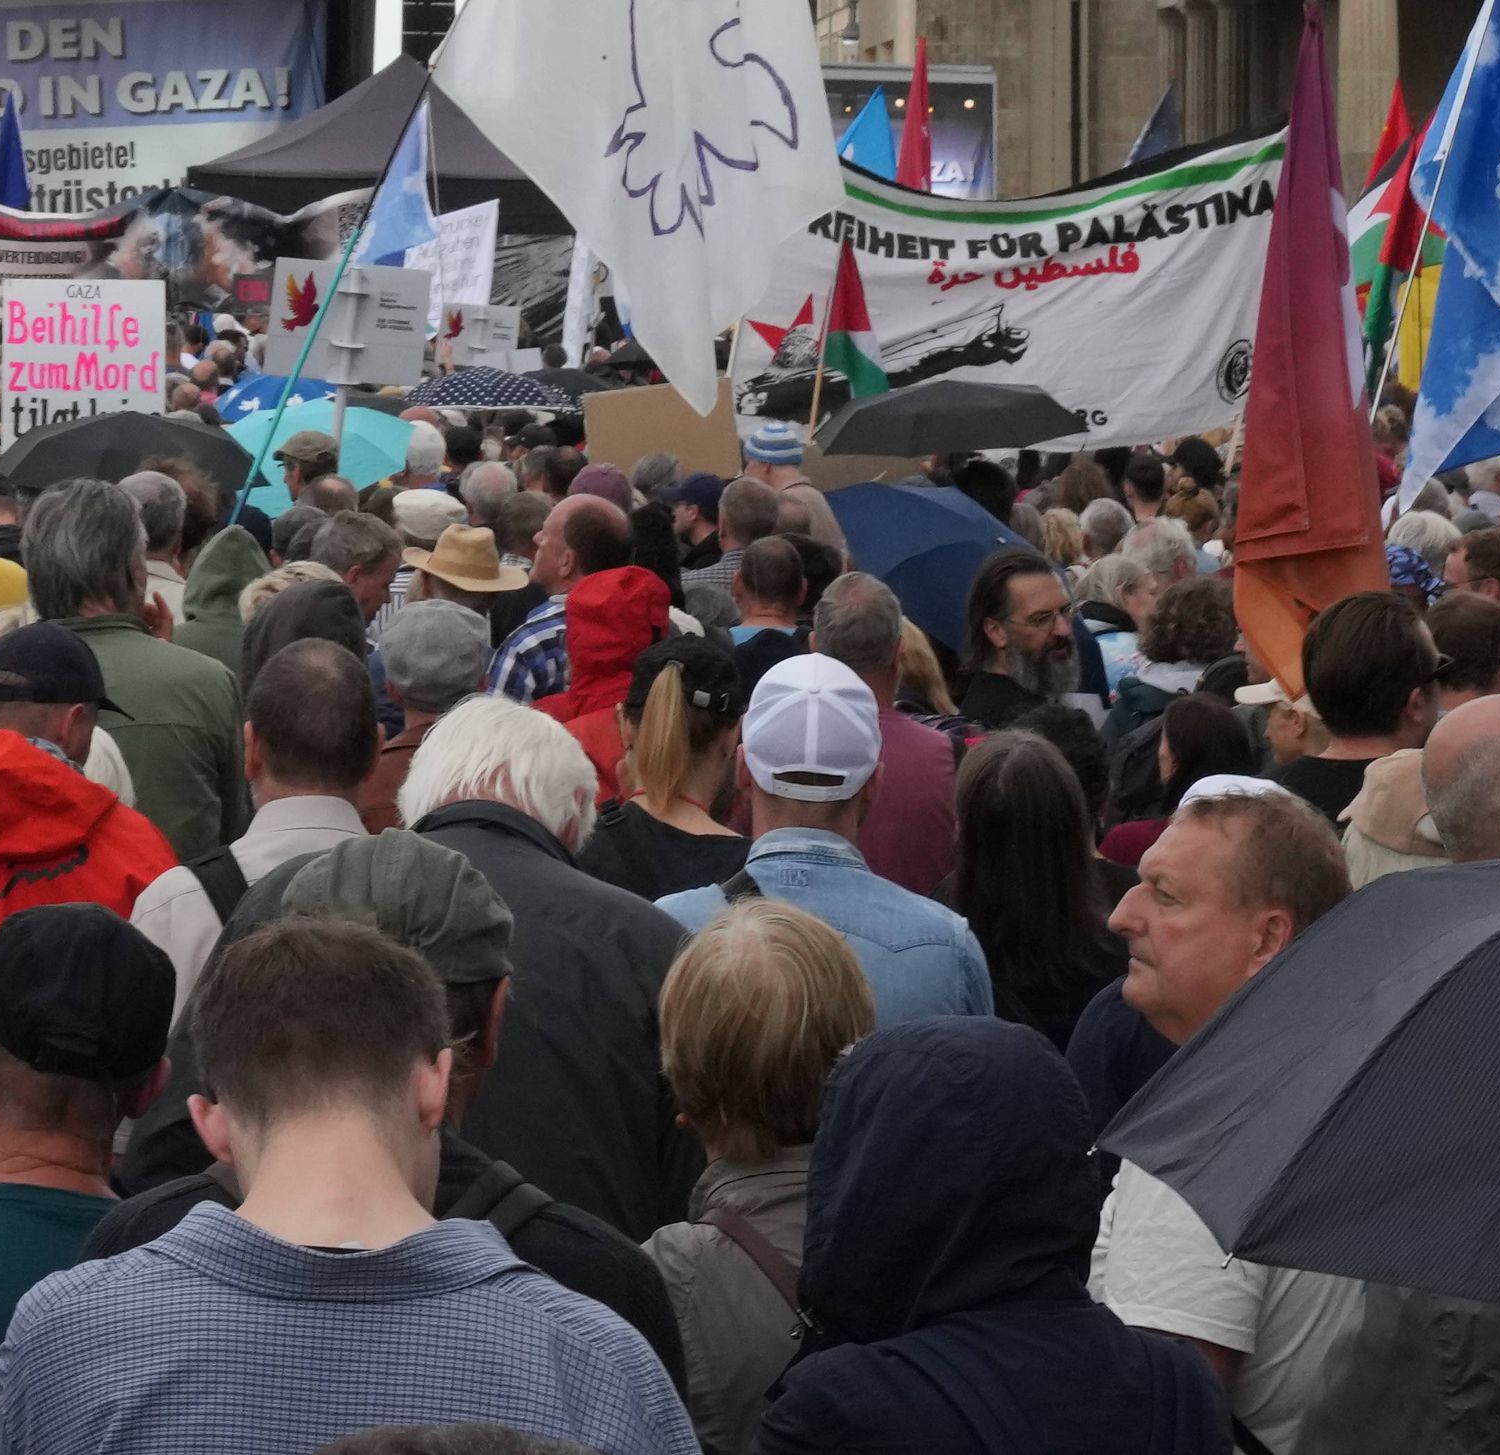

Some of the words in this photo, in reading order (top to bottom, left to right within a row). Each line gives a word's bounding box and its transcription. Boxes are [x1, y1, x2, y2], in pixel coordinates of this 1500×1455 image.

[6, 17, 126, 63] DEN
[38, 74, 104, 118] IN
[115, 67, 292, 115] GAZA!
[930, 159, 976, 183] ZA!
[965, 231, 1048, 259] FÜR
[1056, 179, 1275, 253] PALÄSTINA
[65, 284, 103, 300] GAZA
[7, 300, 141, 353] Beihilfe
